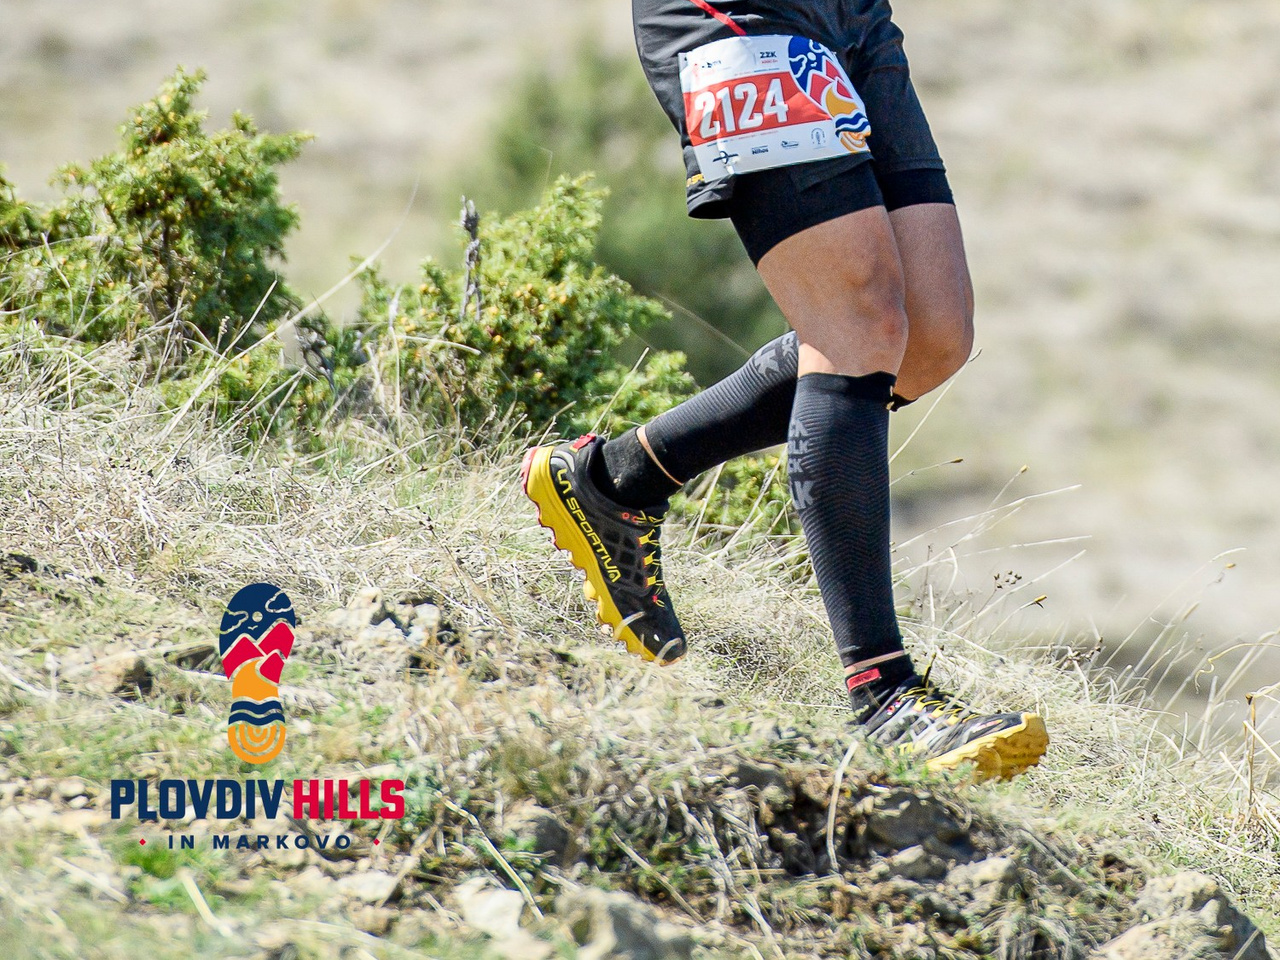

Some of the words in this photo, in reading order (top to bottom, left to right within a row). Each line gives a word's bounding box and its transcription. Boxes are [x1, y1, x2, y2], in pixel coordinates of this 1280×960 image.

[694, 78, 789, 139] 2124
[556, 469, 572, 494] LA
[566, 497, 621, 583] SPORTIVA
